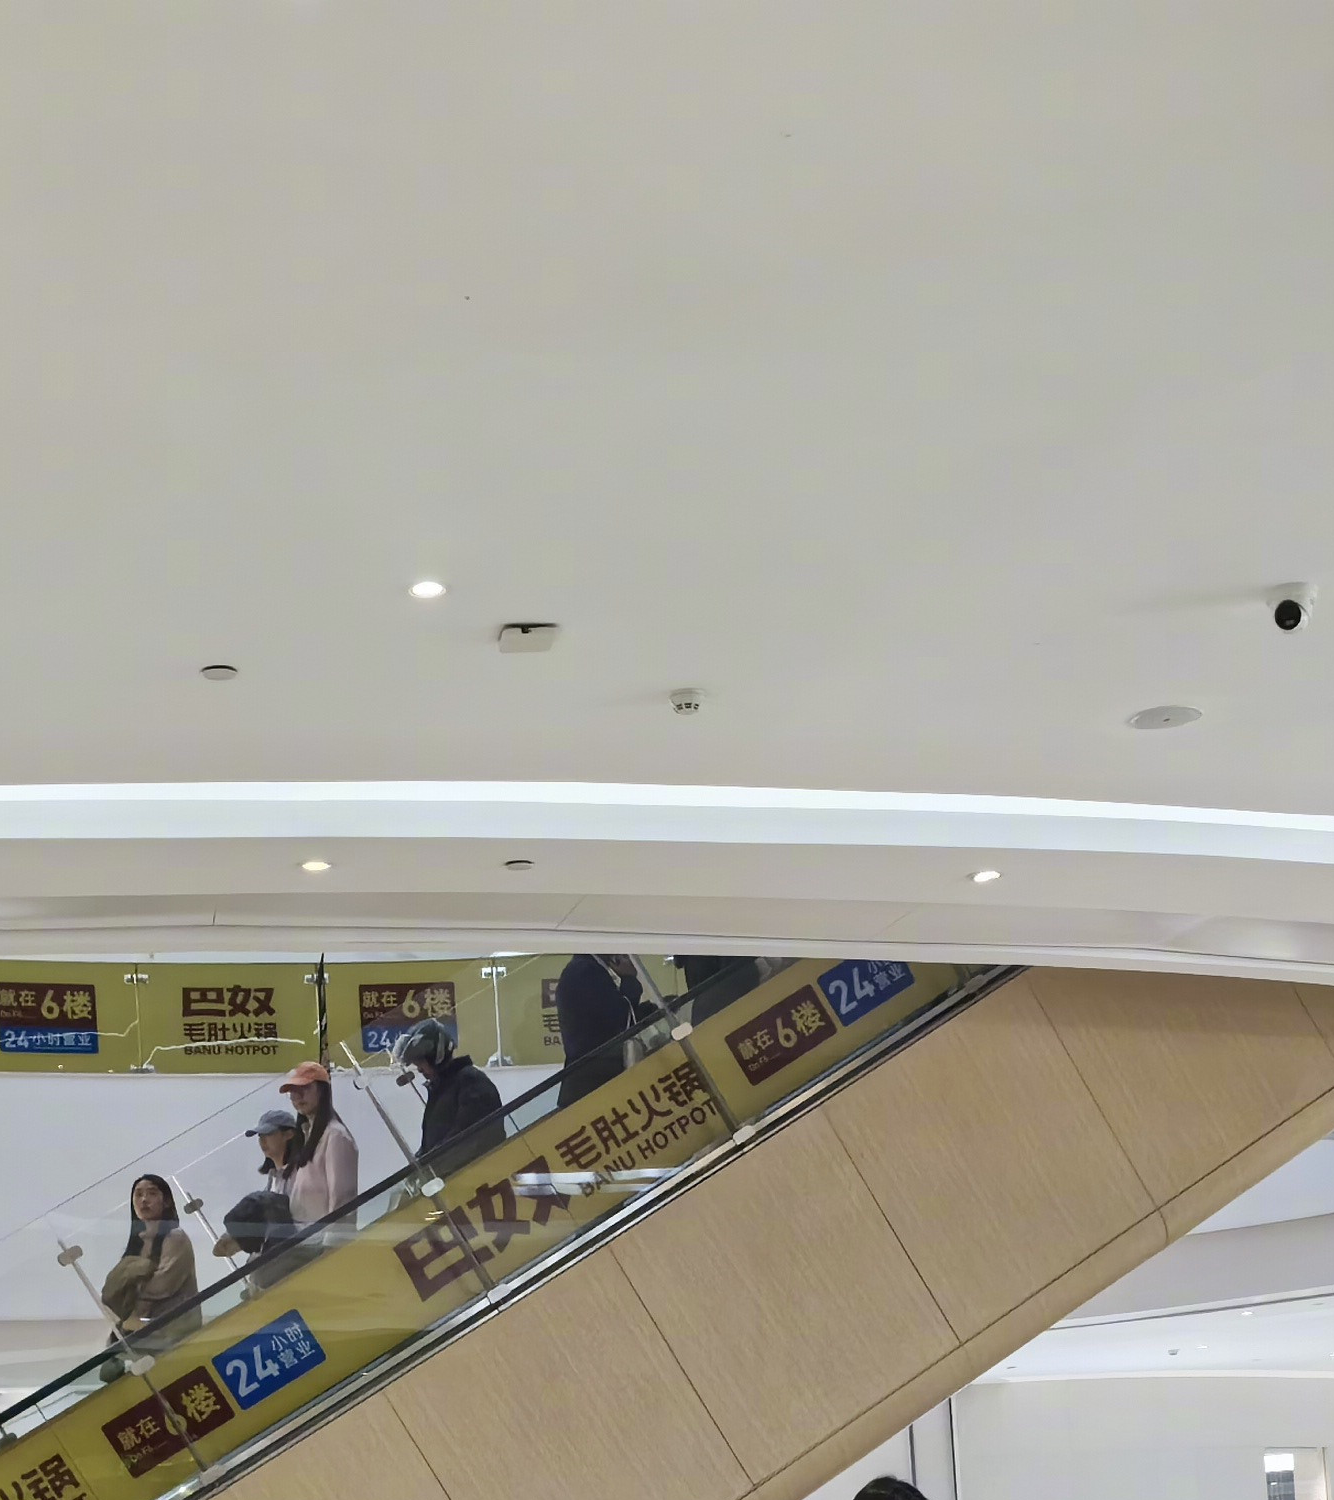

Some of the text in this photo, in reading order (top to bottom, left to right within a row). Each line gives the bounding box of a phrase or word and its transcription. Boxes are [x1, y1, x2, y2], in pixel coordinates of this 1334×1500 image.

[0, 989, 92, 1019] 就在6楼
[182, 985, 275, 1018] 巴奴
[363, 988, 453, 1018] 就在6楼
[829, 967, 875, 1015] 24
[183, 1022, 278, 1043] 毛肚火锅
[184, 1044, 279, 1056] BANU HOTPOT
[737, 1000, 826, 1060] 就在6楼
[555, 1060, 709, 1171] 毛肚火锅
[638, 1099, 720, 1162] HOTPOT
[393, 1154, 569, 1302] 巴奴
[226, 1345, 280, 1398] 24
